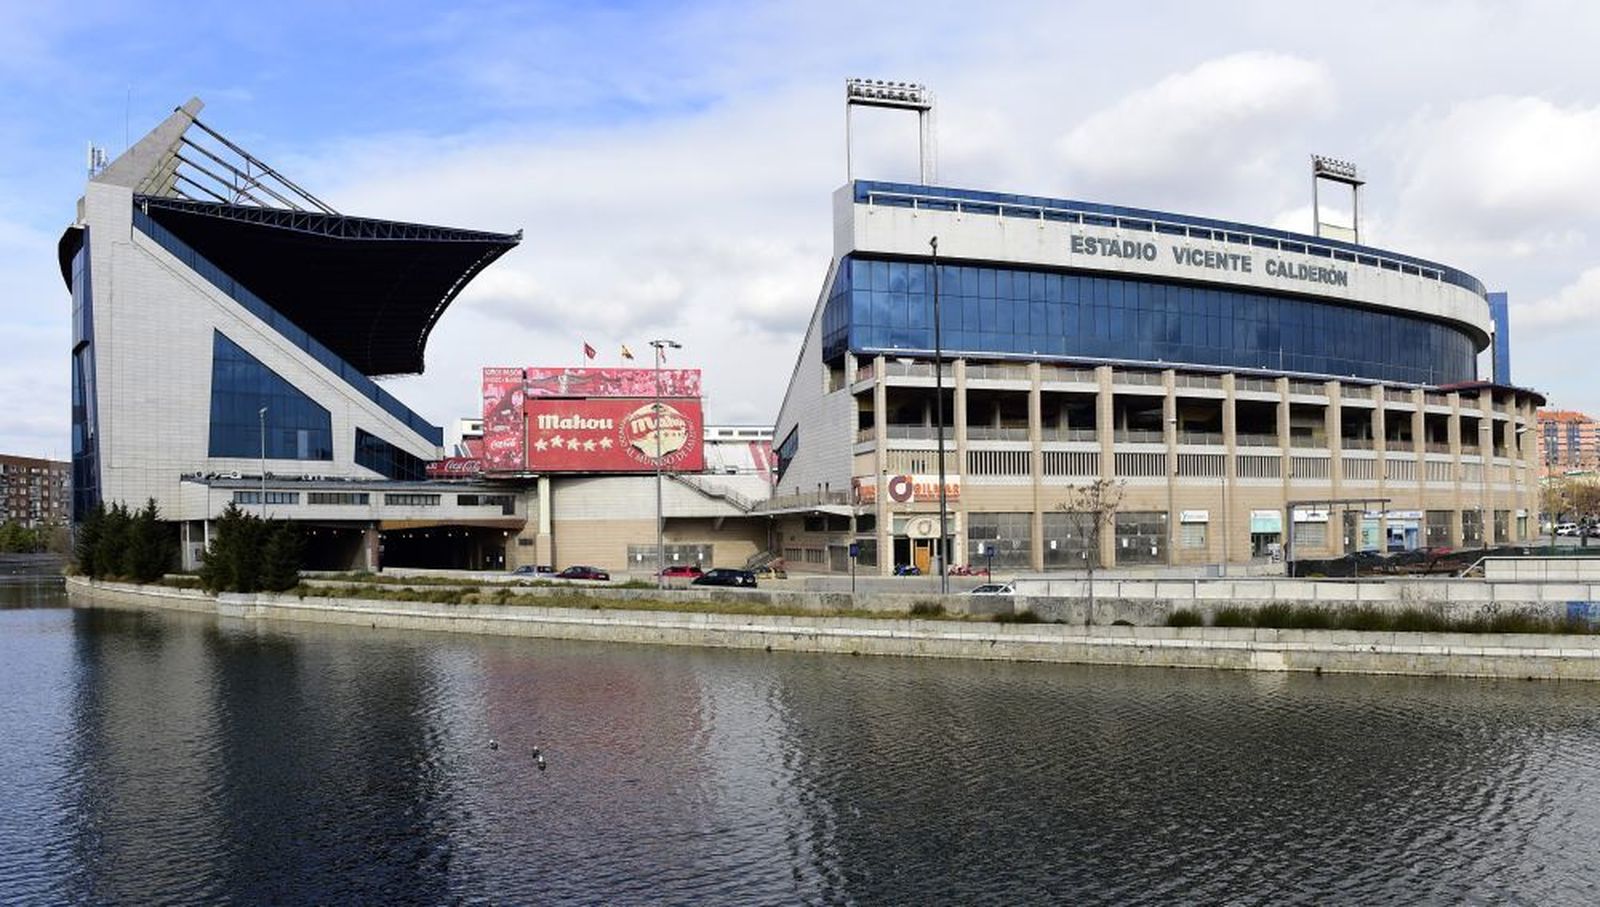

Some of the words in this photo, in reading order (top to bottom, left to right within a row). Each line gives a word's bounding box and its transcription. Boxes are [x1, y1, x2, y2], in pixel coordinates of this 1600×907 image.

[1071, 234, 1157, 261] ESTADIO
[1172, 246, 1252, 273] VICENTE
[537, 414, 614, 430] Mahou
